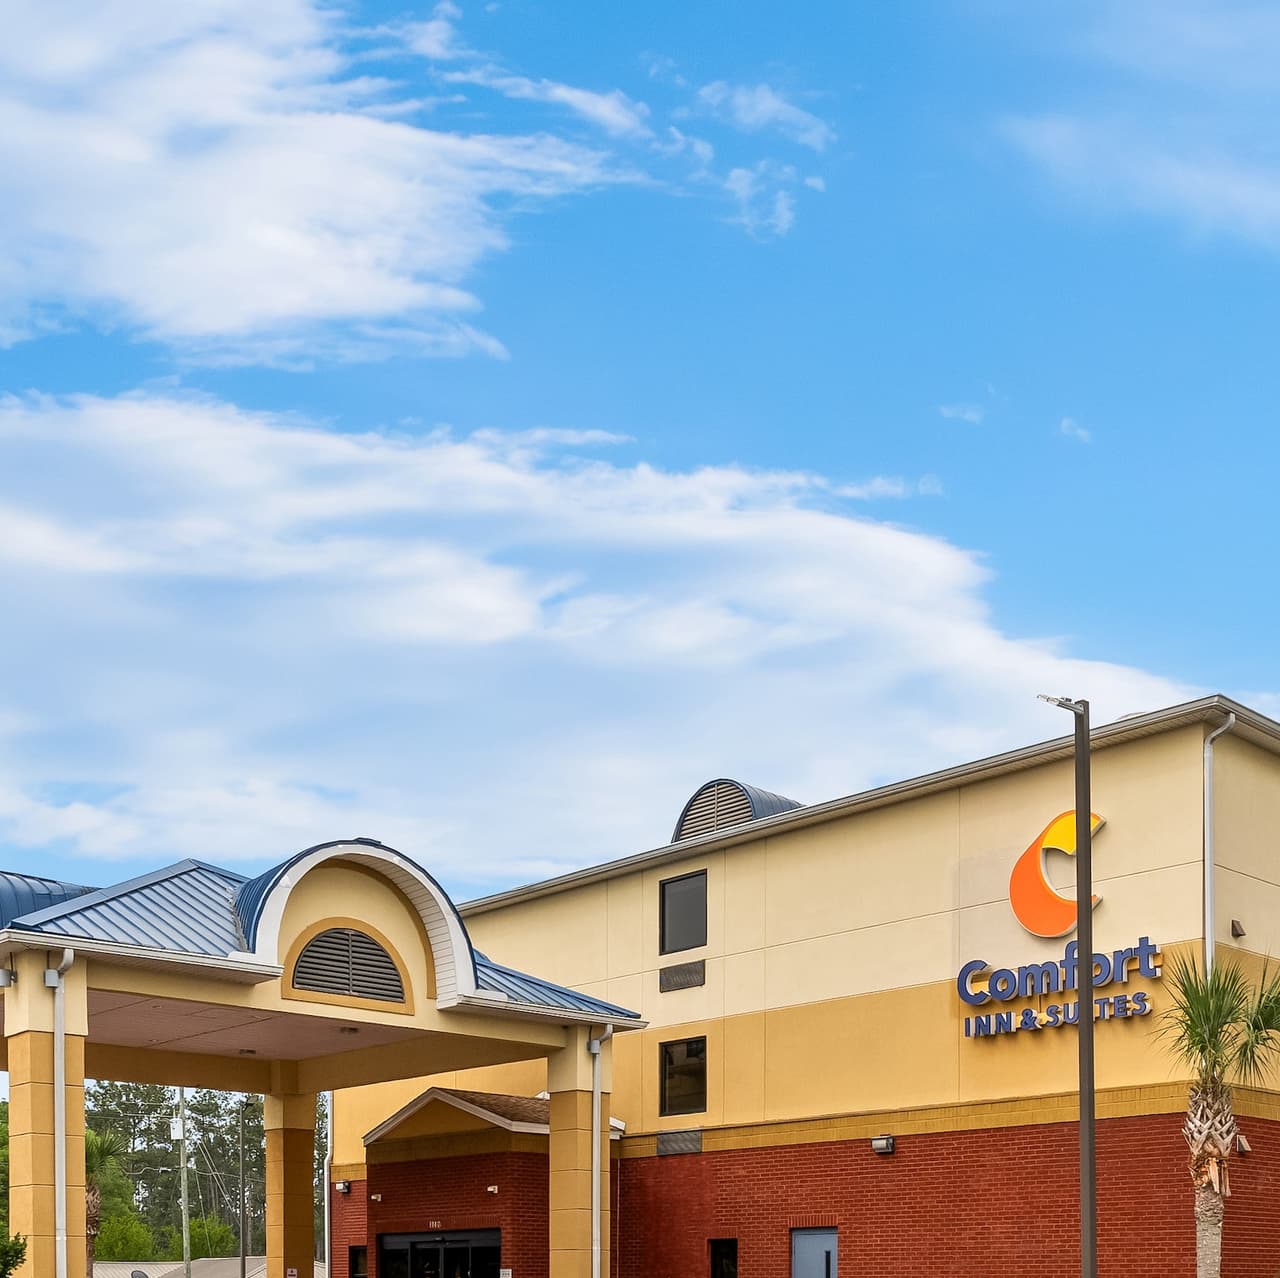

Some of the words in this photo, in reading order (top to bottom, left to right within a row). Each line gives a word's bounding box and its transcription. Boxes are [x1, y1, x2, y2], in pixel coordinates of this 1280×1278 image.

[957, 936, 1162, 1006] Comfort
[964, 1011, 1016, 1037] INN
[1021, 1008, 1042, 1030] &
[1046, 991, 1152, 1028] SUTES
